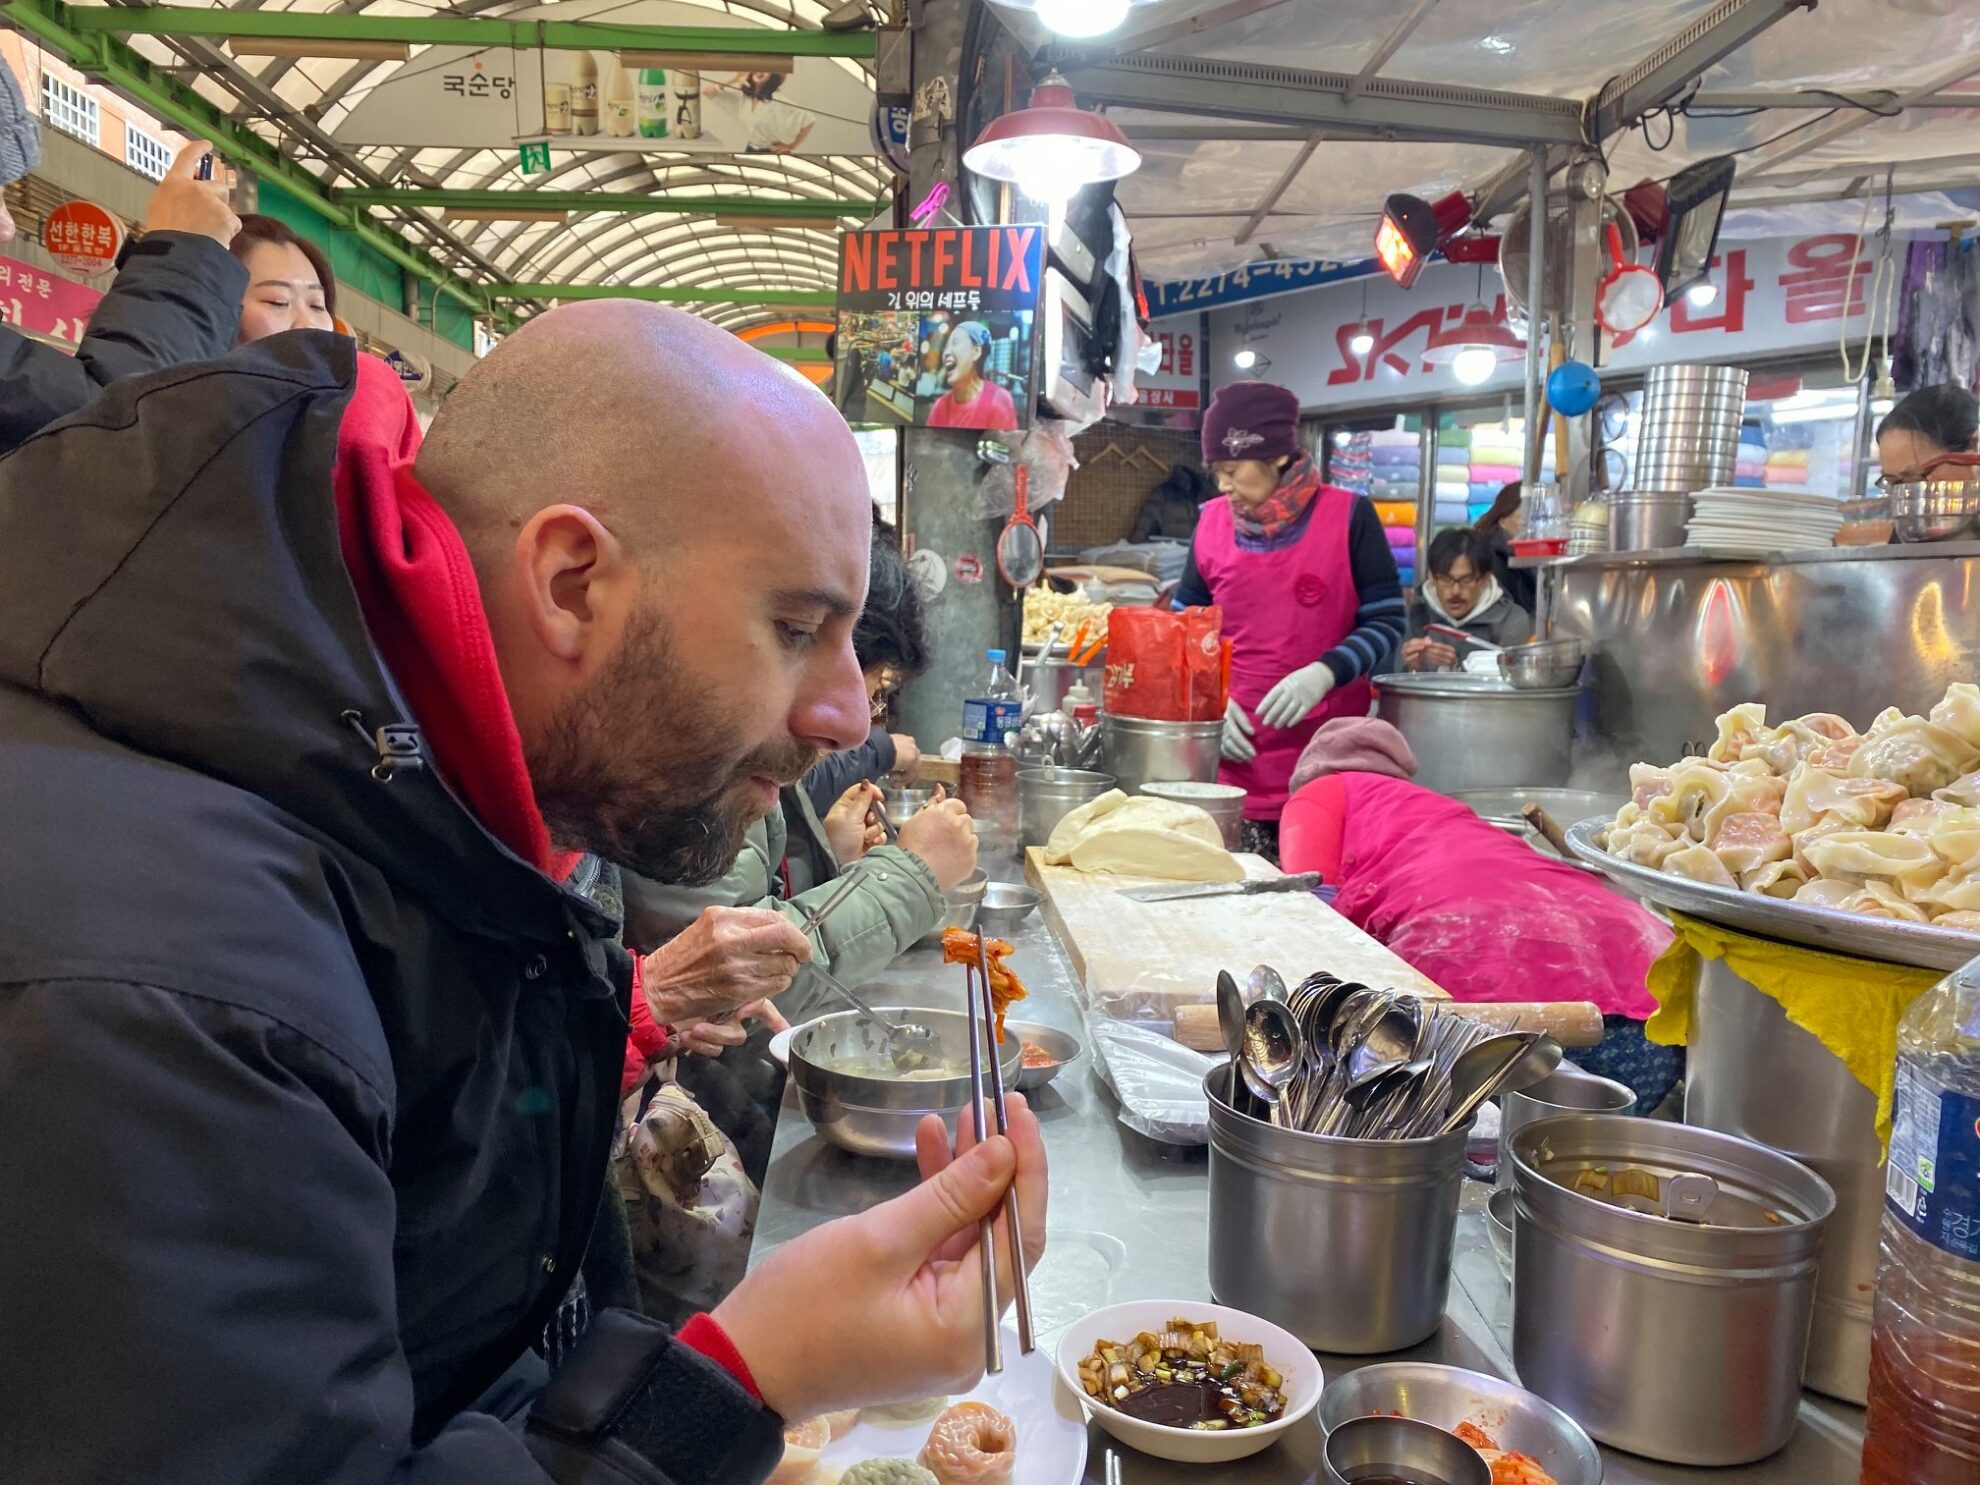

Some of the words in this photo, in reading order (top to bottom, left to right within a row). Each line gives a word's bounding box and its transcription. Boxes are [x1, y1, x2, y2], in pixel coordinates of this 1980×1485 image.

[443, 72, 517, 99] 국순당
[49, 220, 112, 249] 선한한복
[843, 227, 1035, 294] NETFLIX
[905, 291, 934, 309] 위의
